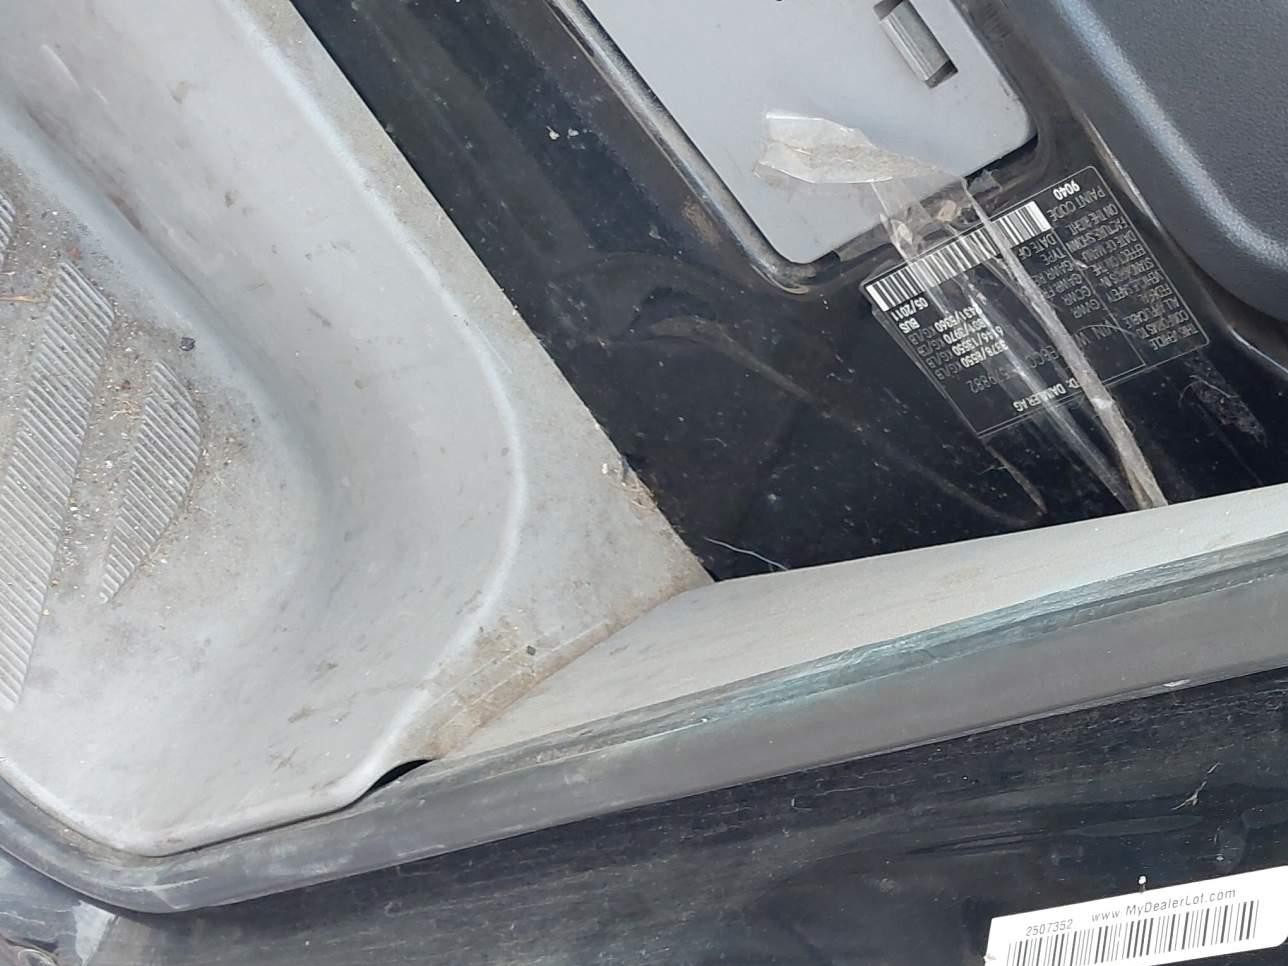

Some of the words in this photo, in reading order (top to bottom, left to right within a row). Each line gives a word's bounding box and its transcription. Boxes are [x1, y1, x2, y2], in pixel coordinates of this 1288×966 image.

[1051, 179, 1080, 200] 9040
[1072, 184, 1105, 208] PAINT
[1045, 199, 1077, 221] CODE
[1015, 245, 1033, 259] OF
[1029, 232, 1057, 253] DATE
[1039, 246, 1066, 265] TYPE
[889, 296, 929, 320] 05/2011
[898, 317, 920, 333] BUS
[941, 315, 991, 343] 801/3970
[1011, 398, 1029, 411] AG
[1025, 918, 1074, 938] 2507352
[1091, 889, 1236, 923] wwwMyDealerLot.com
